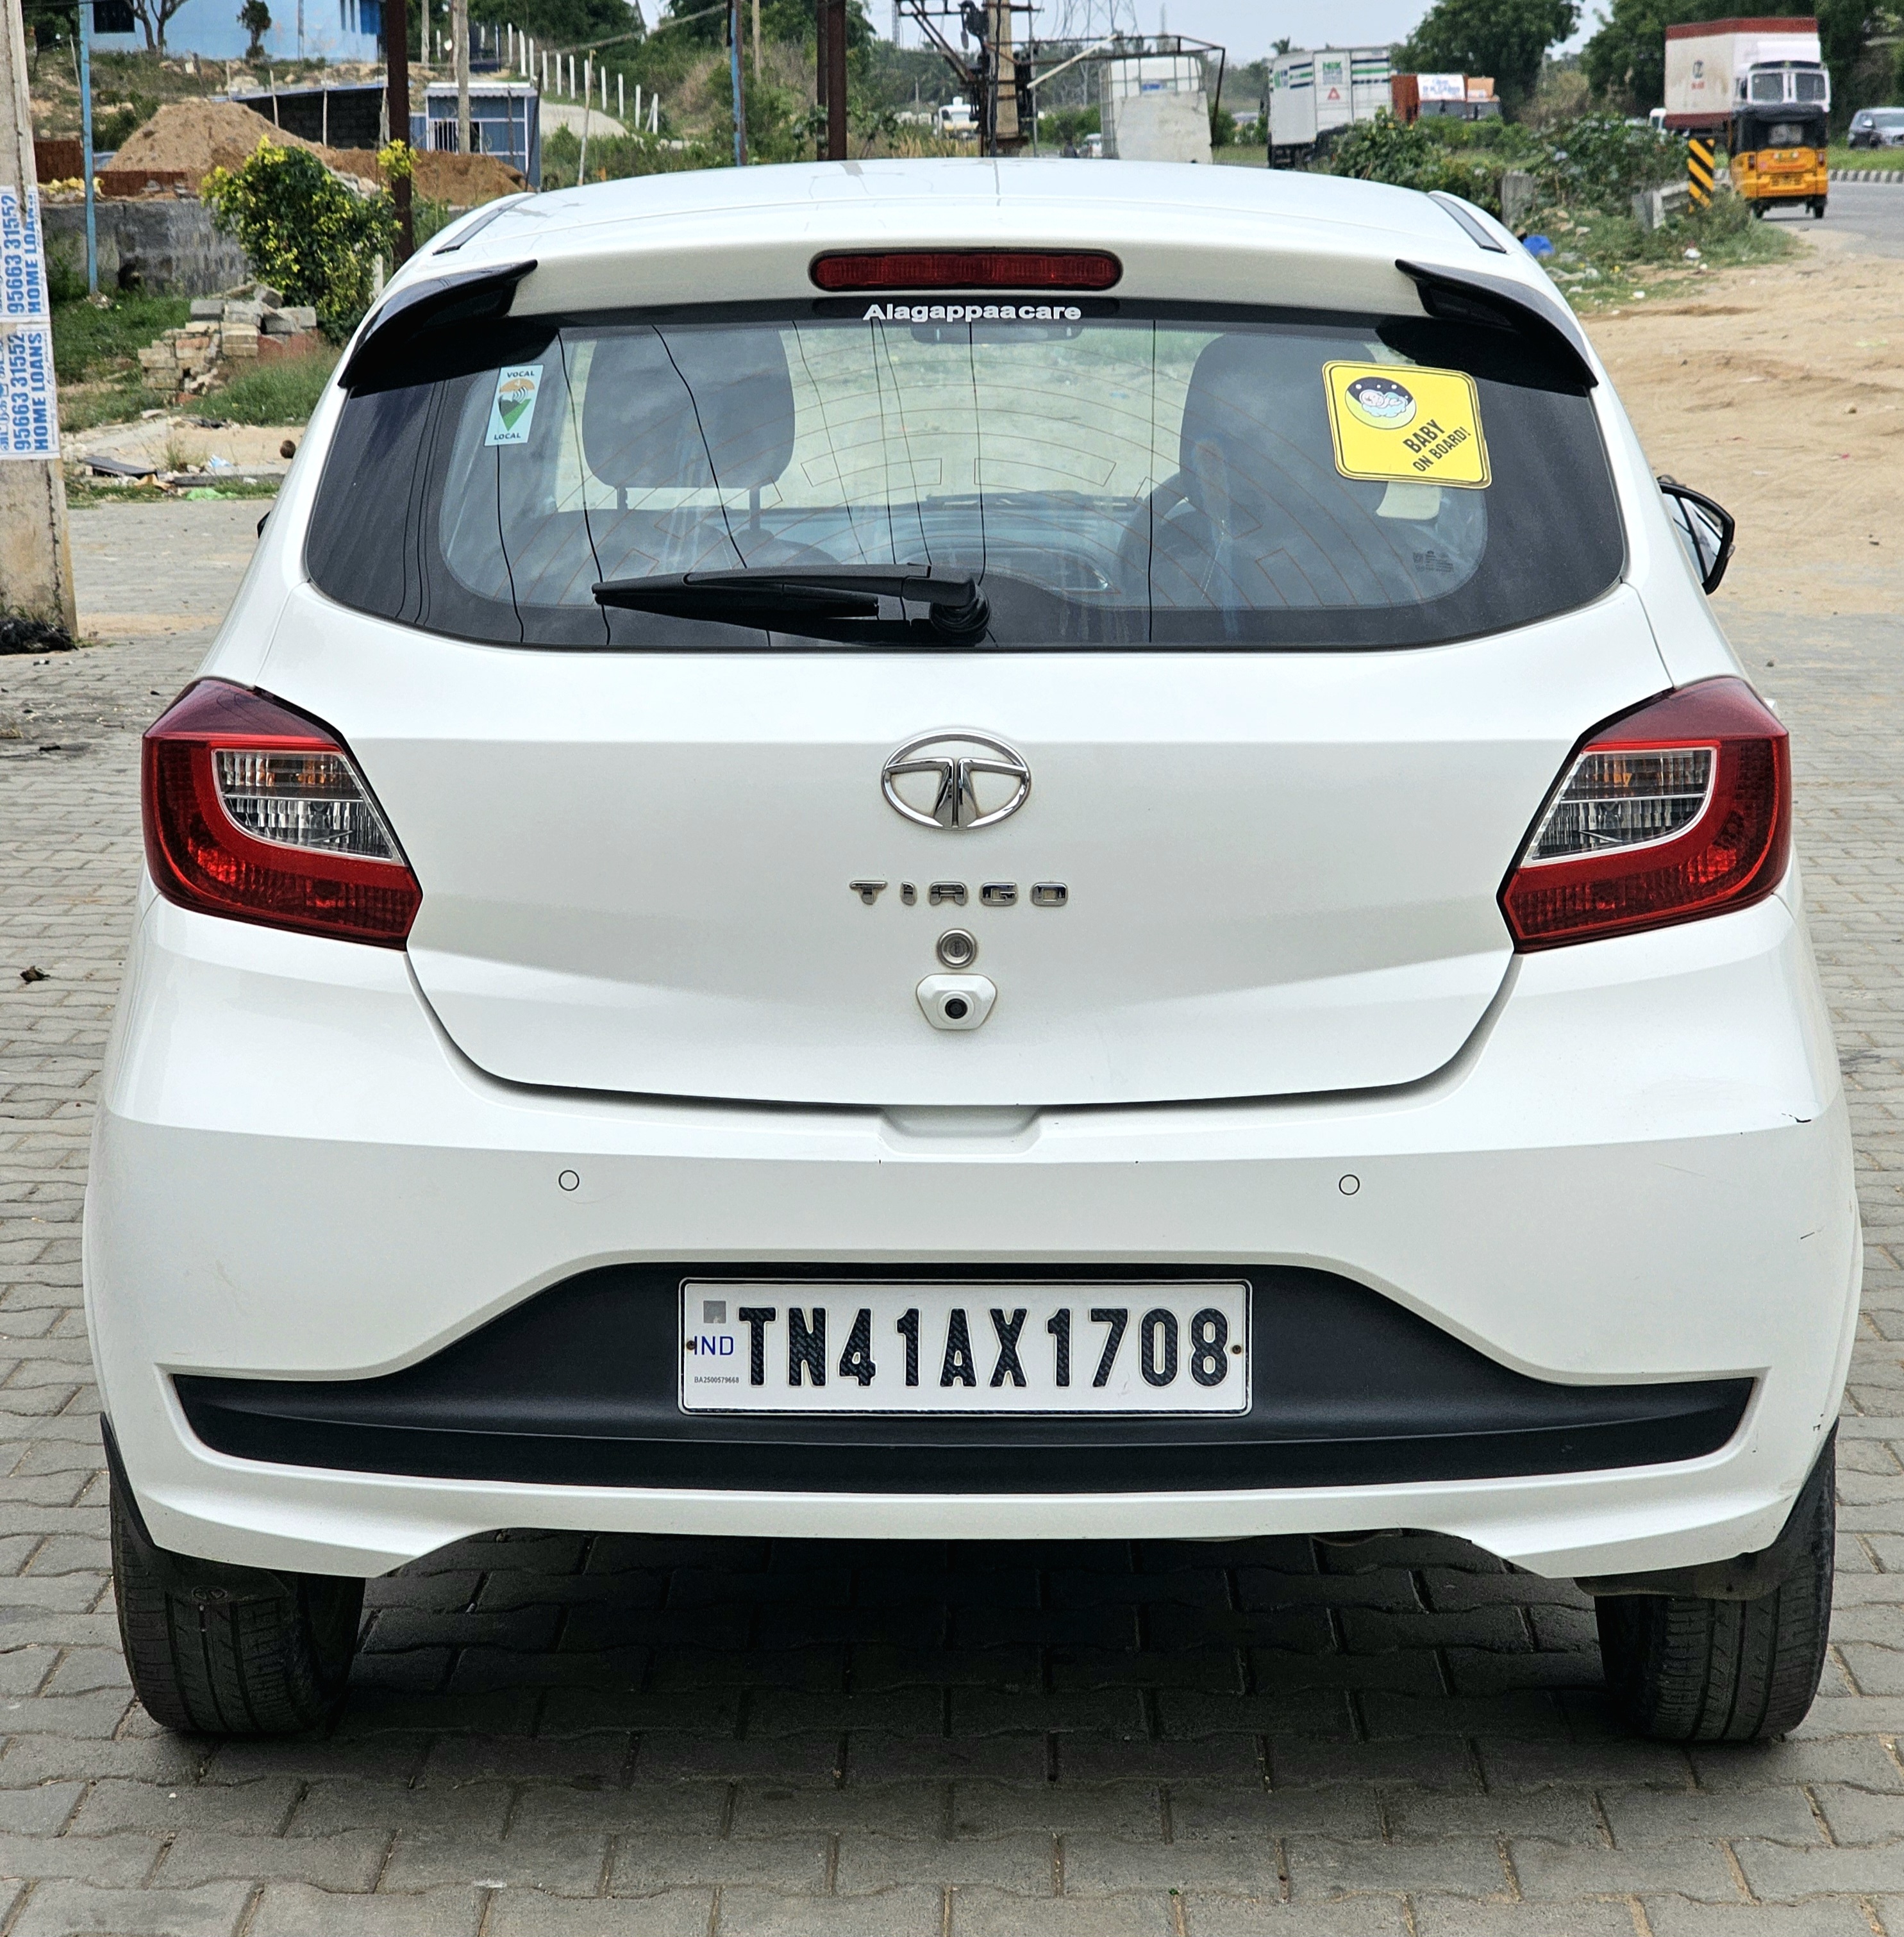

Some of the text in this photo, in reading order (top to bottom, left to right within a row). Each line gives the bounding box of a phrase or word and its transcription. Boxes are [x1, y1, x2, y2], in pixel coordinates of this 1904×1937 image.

[4, 254, 25, 313] 95663
[24, 260, 41, 313] HOME
[8, 332, 31, 451] 95663 31552
[28, 332, 49, 451] HOME LOANS
[1402, 419, 1446, 454] BABY
[1412, 426, 1472, 472] ON BOARD!
[849, 880, 1069, 906] TIAGO
[694, 1335, 734, 1356] IND
[738, 1306, 1229, 1388] TN41AX1708
